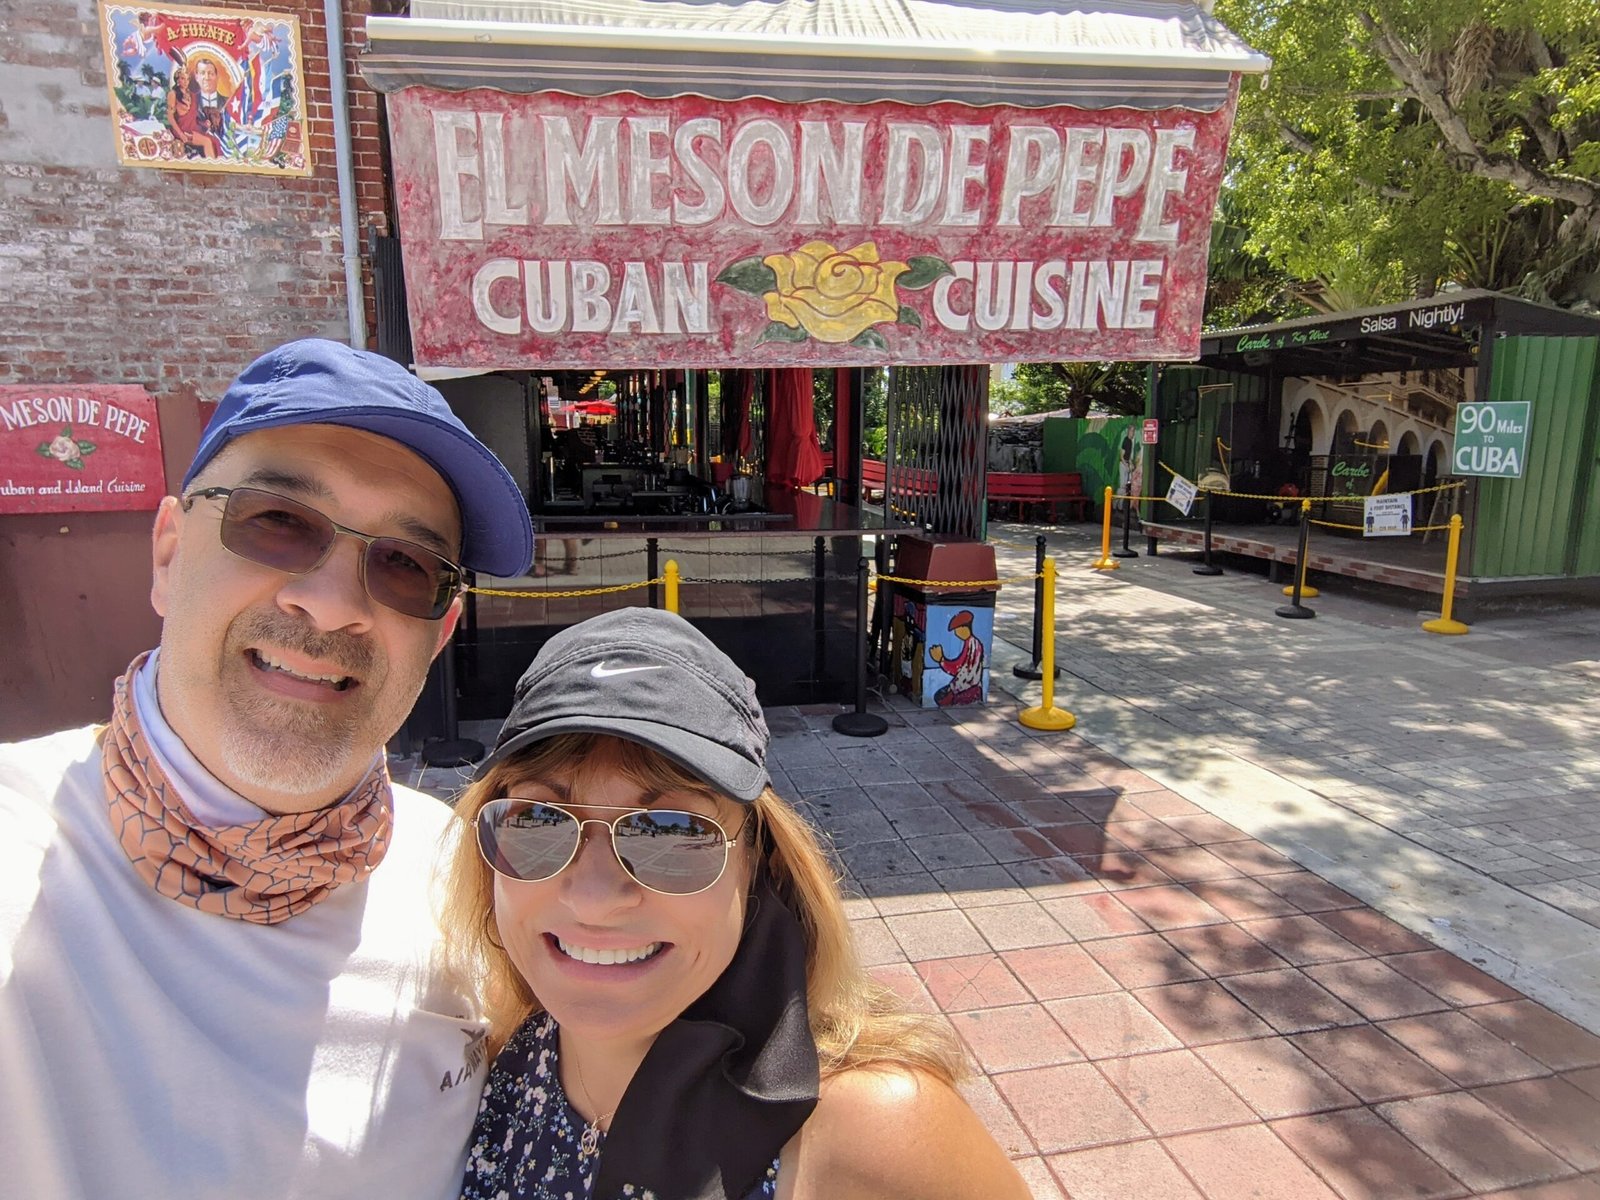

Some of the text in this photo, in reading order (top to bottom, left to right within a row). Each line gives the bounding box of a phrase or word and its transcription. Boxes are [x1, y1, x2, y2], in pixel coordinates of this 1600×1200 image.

[430, 110, 1197, 241] EL MESON DE PEPE
[471, 257, 1164, 335] CUBAN CUISINE
[1360, 303, 1465, 333] Salsa Nightly!
[1236, 330, 1330, 352] Caribe of Key West
[0, 396, 150, 444] MESON DE PEPE
[1461, 405, 1496, 434] 90
[1483, 435, 1495, 443] TO
[1332, 461, 1369, 477] Caribe
[1456, 446, 1519, 474] CUBA
[0, 479, 35, 496] uban
[38, 479, 61, 495] and
[107, 476, 146, 493] Cuisine
